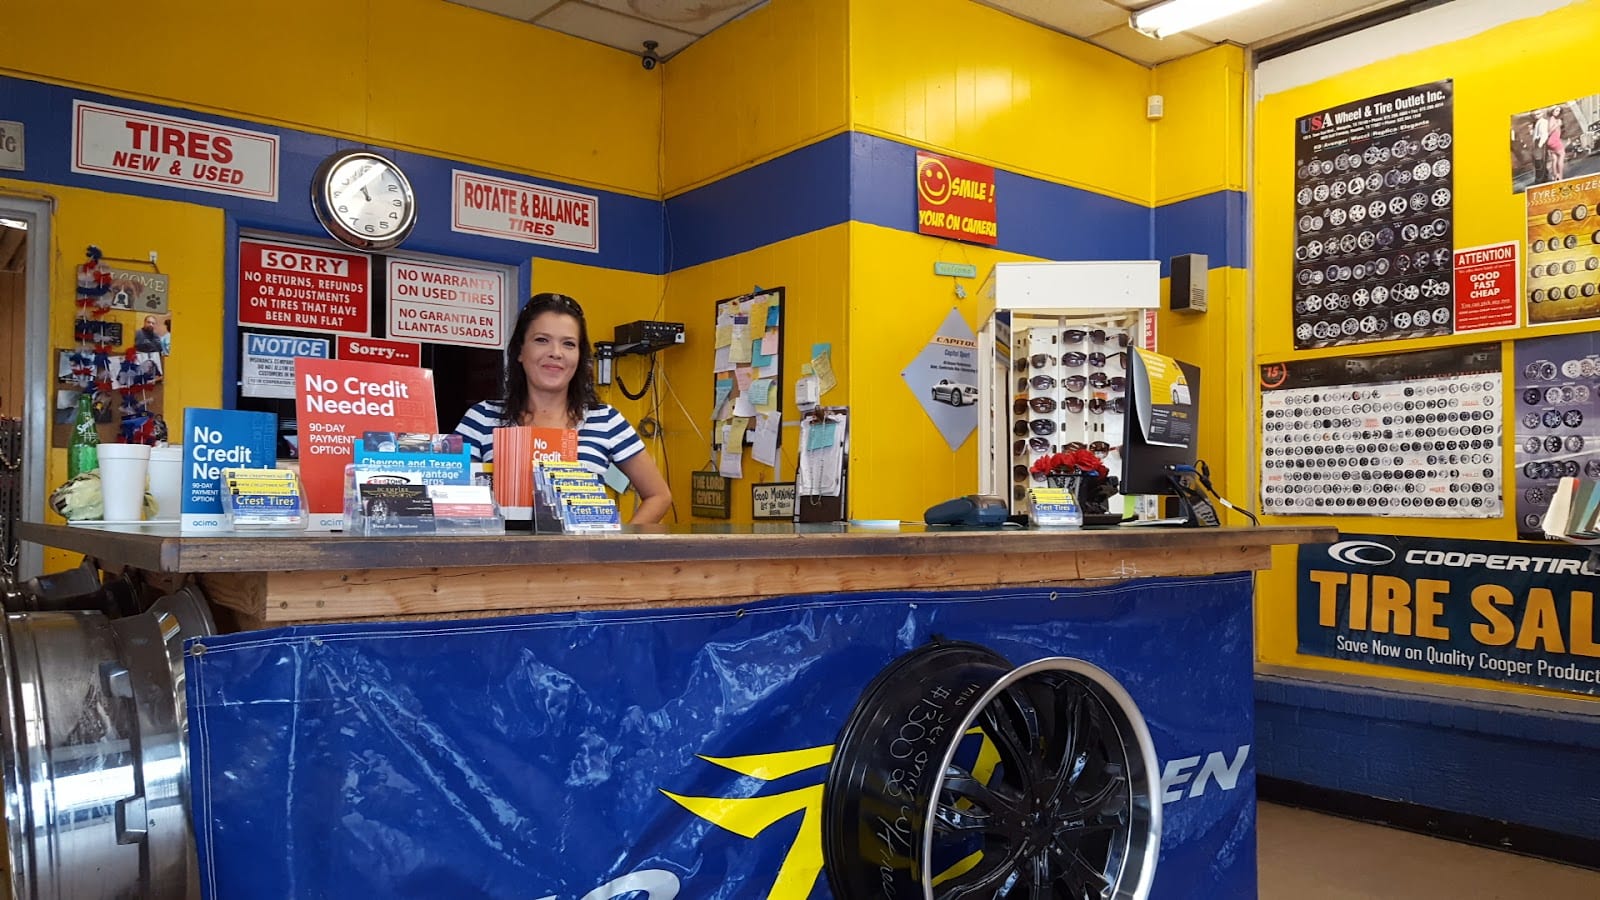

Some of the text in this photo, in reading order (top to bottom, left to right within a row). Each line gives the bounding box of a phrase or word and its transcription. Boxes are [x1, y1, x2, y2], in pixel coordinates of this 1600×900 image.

[1300, 112, 1334, 135] USA
[1334, 107, 1362, 125] Wheel
[1363, 105, 1372, 117] &
[1374, 102, 1393, 115] Tire
[1395, 92, 1425, 111] Outlet
[1427, 90, 1446, 103] Inc.
[125, 120, 234, 164] TIRES
[112, 151, 245, 186] NEW & USED
[951, 177, 996, 204] SMILE !
[1531, 188, 1556, 201] TYRE
[464, 181, 590, 227] ROTATE & BALANCE
[509, 217, 555, 237] TIRES
[919, 210, 997, 238] YOUR ON CAMERA
[266, 252, 343, 274] SORRY
[1458, 247, 1512, 266] ATTENTION
[244, 271, 364, 293] NO RETURNS, REFUNDS
[397, 268, 495, 291] NO WARRANTY
[1469, 271, 1500, 283] GOOD
[1473, 279, 1496, 290] FAST
[259, 285, 350, 304] OR ADJUSTMENTS
[397, 284, 495, 306] ON USED TIRES
[1470, 287, 1501, 299] CHEAP
[250, 297, 357, 317] ON TIRES THAT HAVE
[265, 311, 344, 327] BEEN RUN FLAT
[399, 308, 493, 327] NO GARANTIA EN
[398, 321, 495, 339] LLANTAS USADAS
[251, 337, 323, 357] NOTICE
[349, 342, 410, 359] Sorry...
[936, 336, 977, 348] CAPITOL
[305, 373, 409, 399] No Credit
[306, 395, 395, 417] Needed
[194, 426, 223, 444] No
[309, 422, 345, 433] 90-DAY
[310, 435, 356, 444] PAYMENT
[534, 438, 547, 450] No
[192, 445, 252, 464] Credit
[310, 445, 350, 455] OPTION
[533, 450, 562, 462] Credit
[362, 457, 463, 470] Chevron and Texaco
[236, 496, 295, 506] Crest Tires
[571, 506, 614, 516] Crest Tires
[192, 519, 218, 527] acima
[320, 519, 344, 527] acim
[1309, 569, 1450, 641] TIRE
[1336, 634, 1368, 654] Save
[1372, 640, 1400, 658] Now
[1405, 647, 1422, 661] on
[1426, 646, 1475, 670] Quality
[1479, 652, 1533, 677] Cooper
